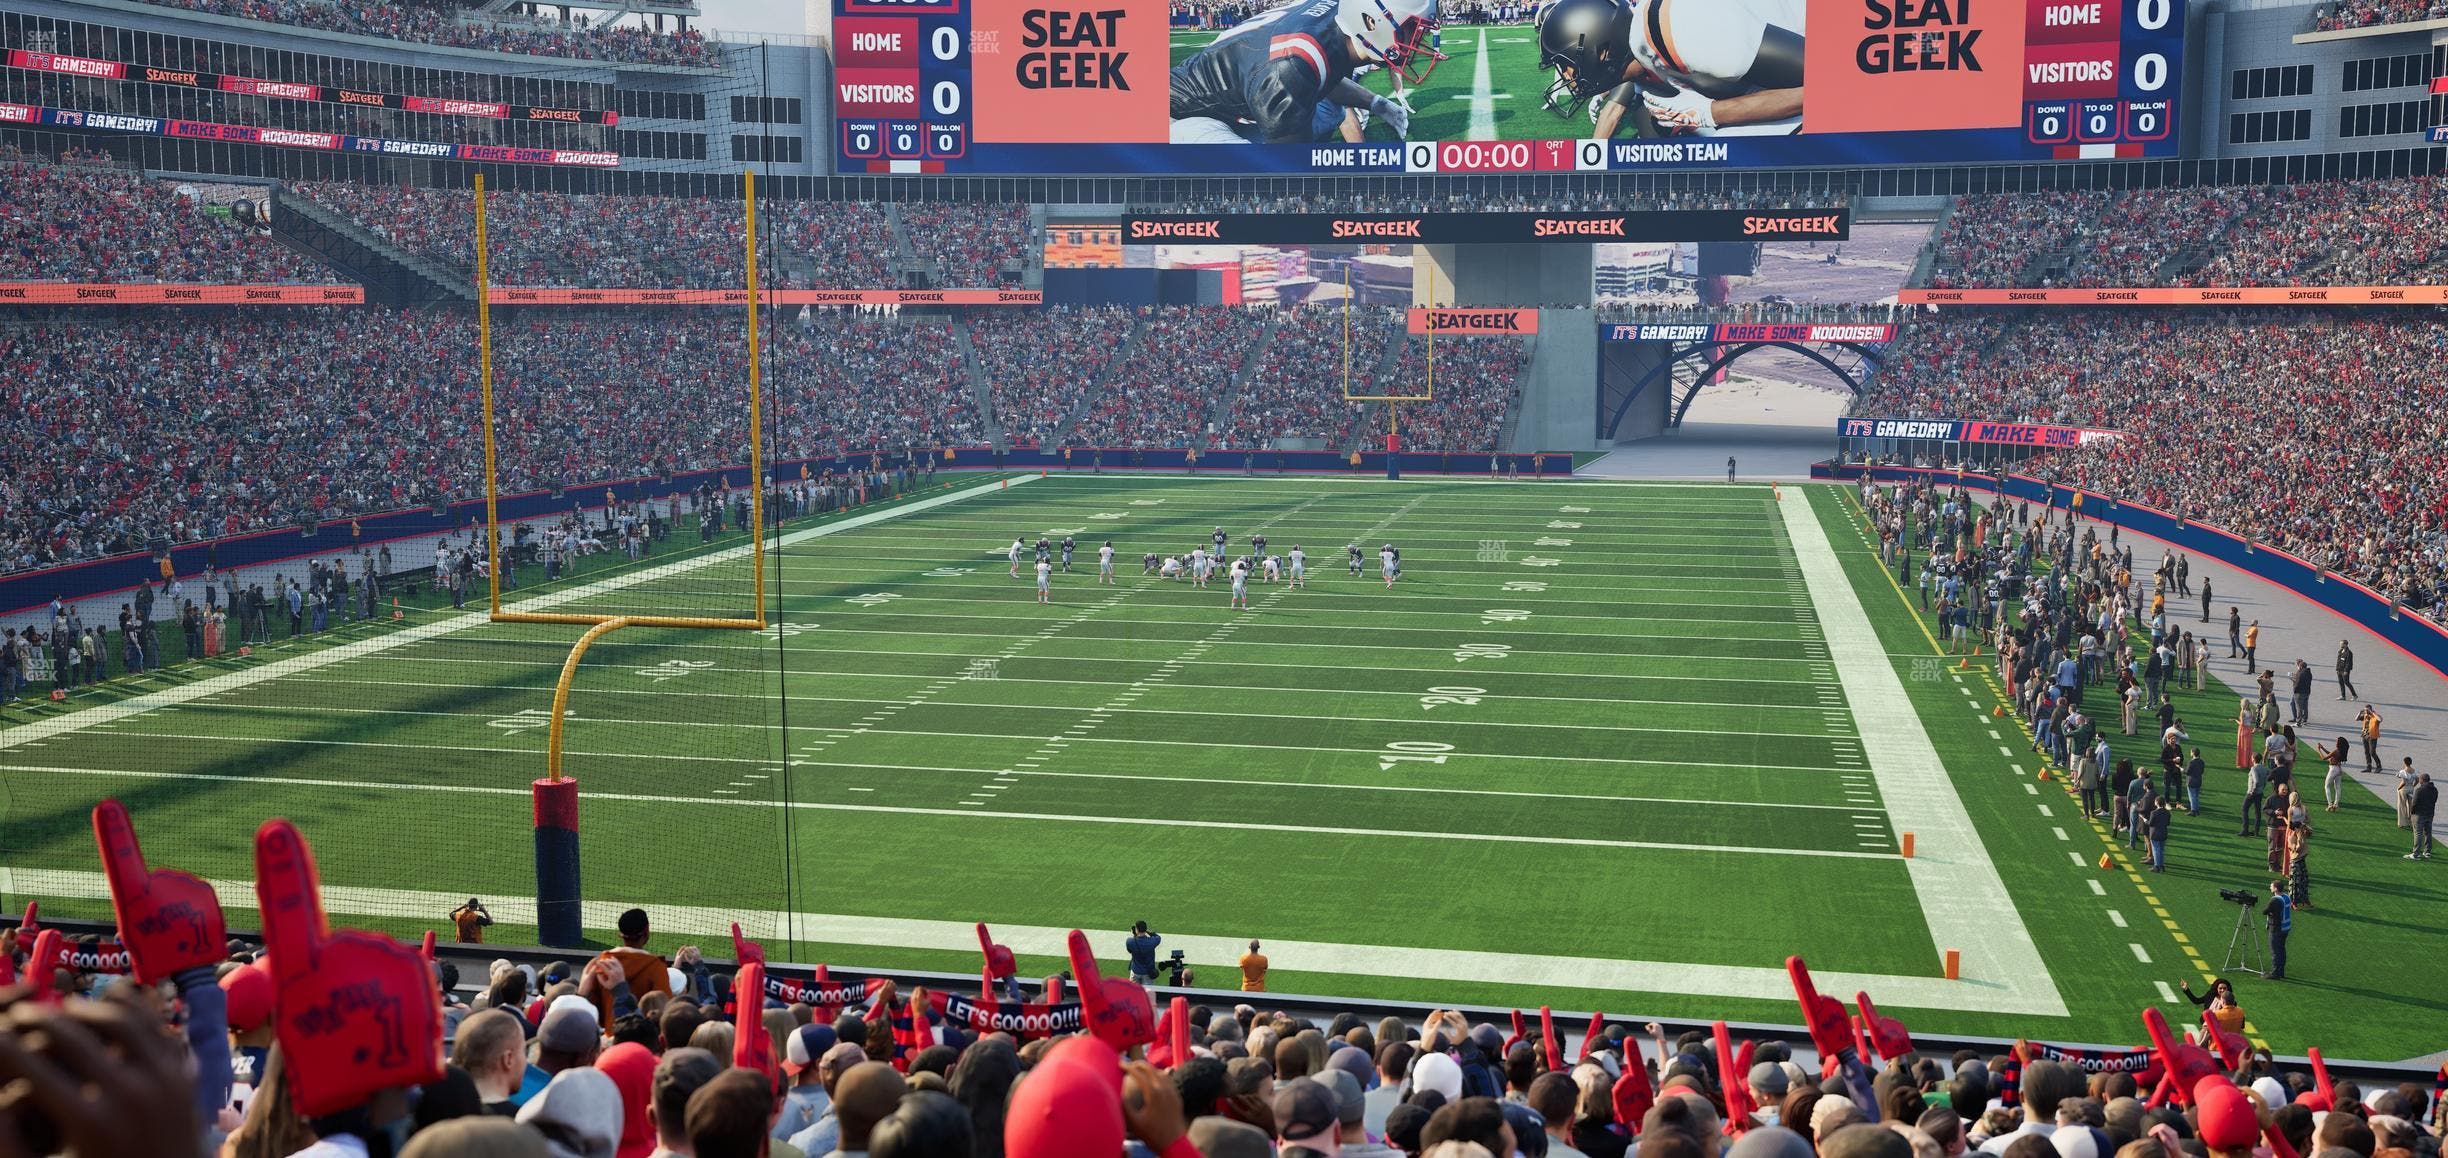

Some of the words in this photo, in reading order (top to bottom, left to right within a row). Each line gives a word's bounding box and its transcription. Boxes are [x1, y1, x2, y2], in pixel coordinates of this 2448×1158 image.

[2045, 4, 2101, 27] HOME
[2137, 0, 2170, 30] 0
[1022, 9, 1126, 48] SEAT
[852, 33, 901, 52] HOME
[932, 26, 960, 61] 0
[1856, 29, 1983, 74] GEEK
[27, 54, 49, 67] IT'S
[53, 57, 114, 76] GAMEDAY!
[1016, 52, 1131, 91] GEEK
[2029, 60, 2113, 84] VISITORS
[2134, 53, 2168, 91] 0
[146, 68, 197, 86] SEATGEEK
[256, 82, 310, 98] GAMEDAY!
[339, 90, 385, 106] SEATGEEK
[840, 84, 915, 104] VISITORS
[932, 80, 960, 115] 0
[444, 101, 499, 116] GAMEDAY!
[529, 108, 581, 122] SEATGEEK
[2037, 106, 2065, 114] DOWN
[2085, 105, 2098, 113] TO
[2099, 103, 2114, 112] GO
[2130, 102, 2151, 111] BALL
[2152, 102, 2166, 110] ON
[2042, 117, 2059, 135] 0
[2090, 115, 2106, 134] 0
[2138, 113, 2156, 132] 0
[55, 111, 82, 125] IT'S
[86, 113, 158, 132] GAMEDAY!
[178, 122, 217, 137] MAKE
[222, 126, 258, 141] SOME
[356, 138, 380, 151] IT'S
[383, 140, 451, 157] GAMEDAY!
[469, 148, 507, 161] MAKE
[514, 150, 551, 162] SOME
[856, 133, 870, 151] 0
[897, 133, 912, 151] 0
[938, 134, 953, 151] 0
[1546, 140, 1564, 149] QRT
[1312, 149, 1354, 166] HOME
[1359, 148, 1400, 166] TEAM
[1412, 145, 1431, 168] 0
[1443, 144, 1529, 168] 00:00
[1551, 150, 1558, 166] 1
[1582, 142, 1602, 166] 0
[1615, 144, 1683, 163] VISITORS
[1685, 143, 1728, 161] TEAM
[1131, 220, 1220, 238] SEATGEEK
[1332, 219, 1421, 238] SEATGEEK
[1534, 218, 1625, 236] SEATGEEK
[1743, 215, 1839, 235] SEATGEEK
[77, 288, 117, 299] SEATGEEK
[165, 289, 201, 299] SEATGEEK
[246, 289, 281, 299] SEATGEEK
[323, 290, 356, 299] SEATGEEK
[641, 292, 676, 300] SEATGEEK
[724, 293, 763, 301] SEATGK
[816, 293, 862, 301] SEATGEEK
[898, 293, 944, 301] SEATGEEK
[998, 293, 1040, 301] SEATGEEK
[1927, 292, 1962, 300] SEATGEEK
[2009, 292, 2047, 300] SEATGEEK
[2097, 291, 2138, 301] SEATGEEK
[2201, 291, 2241, 300] SEATGEEK
[2289, 291, 2327, 300] SEATGEEK
[2370, 290, 2404, 299] SEATGEEK
[1426, 312, 1519, 331] SEATGEEK
[1612, 326, 1638, 339] IT'S
[1640, 326, 1708, 340] GAMEDAY!
[1726, 326, 1766, 339] MAKE
[1770, 326, 1806, 340] SOME
[1846, 420, 1873, 436] IT'S
[1876, 420, 1952, 438] GAMEDAY!
[1979, 425, 2037, 443] MAKE
[2044, 428, 2077, 446] SOME
[1452, 643, 1512, 658] 30
[1420, 686, 1487, 705] 20
[1379, 741, 1455, 764] 10
[764, 977, 795, 1000] LET'S
[796, 984, 865, 1003] GOOOOO!!!
[946, 997, 988, 1027] LET'S
[990, 1007, 1080, 1032] GOOOOO!!!
